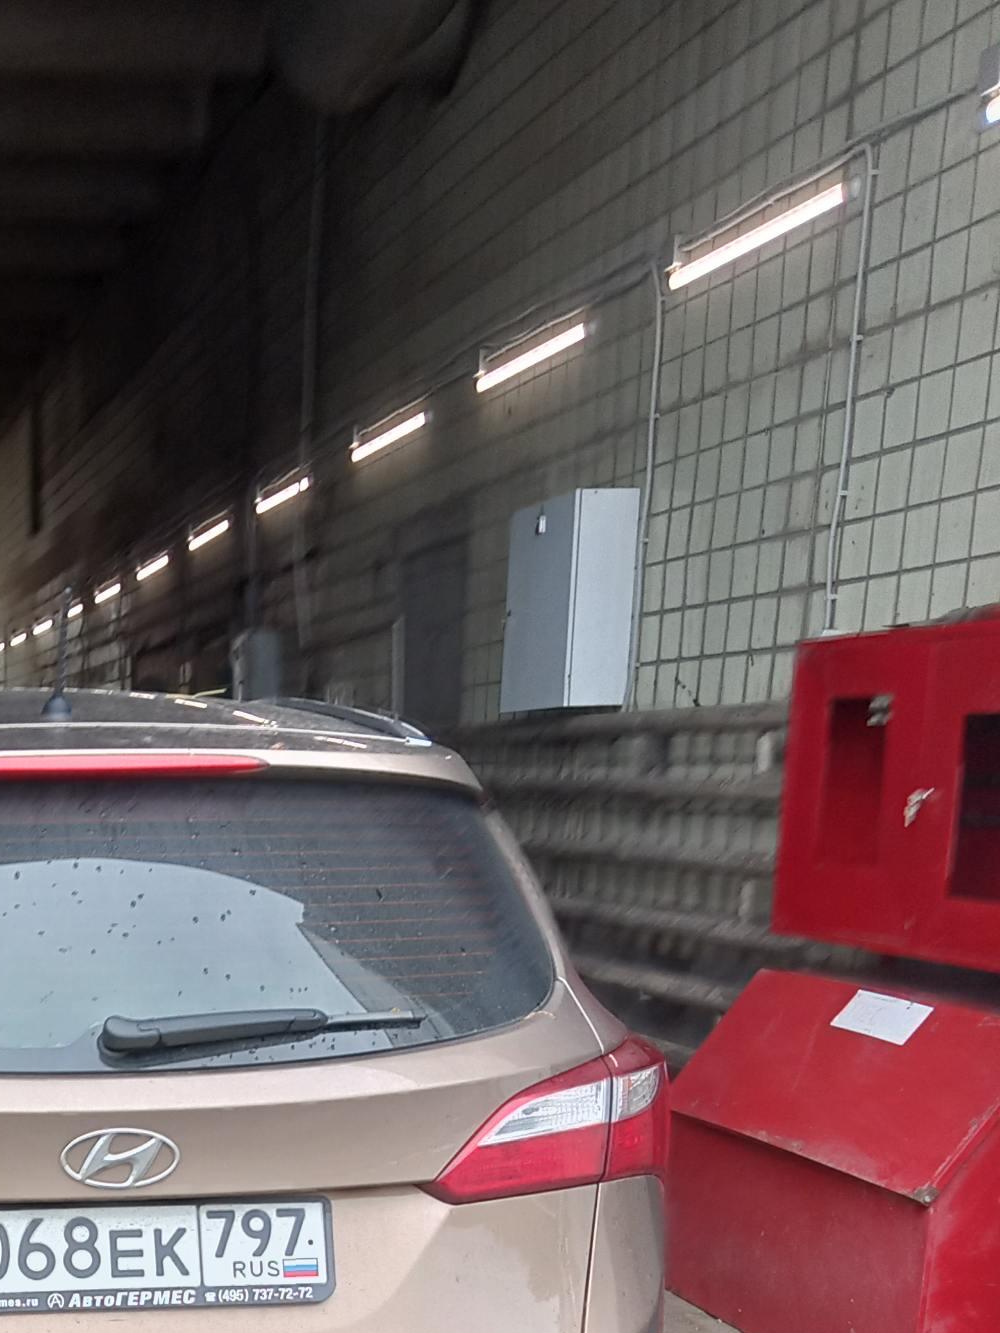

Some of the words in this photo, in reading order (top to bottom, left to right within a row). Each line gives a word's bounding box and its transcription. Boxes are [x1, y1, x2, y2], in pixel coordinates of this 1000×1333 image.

[206, 1208, 307, 1259] 797
[233, 1260, 280, 1278] RUS
[68, 1289, 197, 1308] АвтоГЕРМЕС
[218, 1288, 249, 1303] (495)
[252, 1286, 313, 1301] 737-72-72
